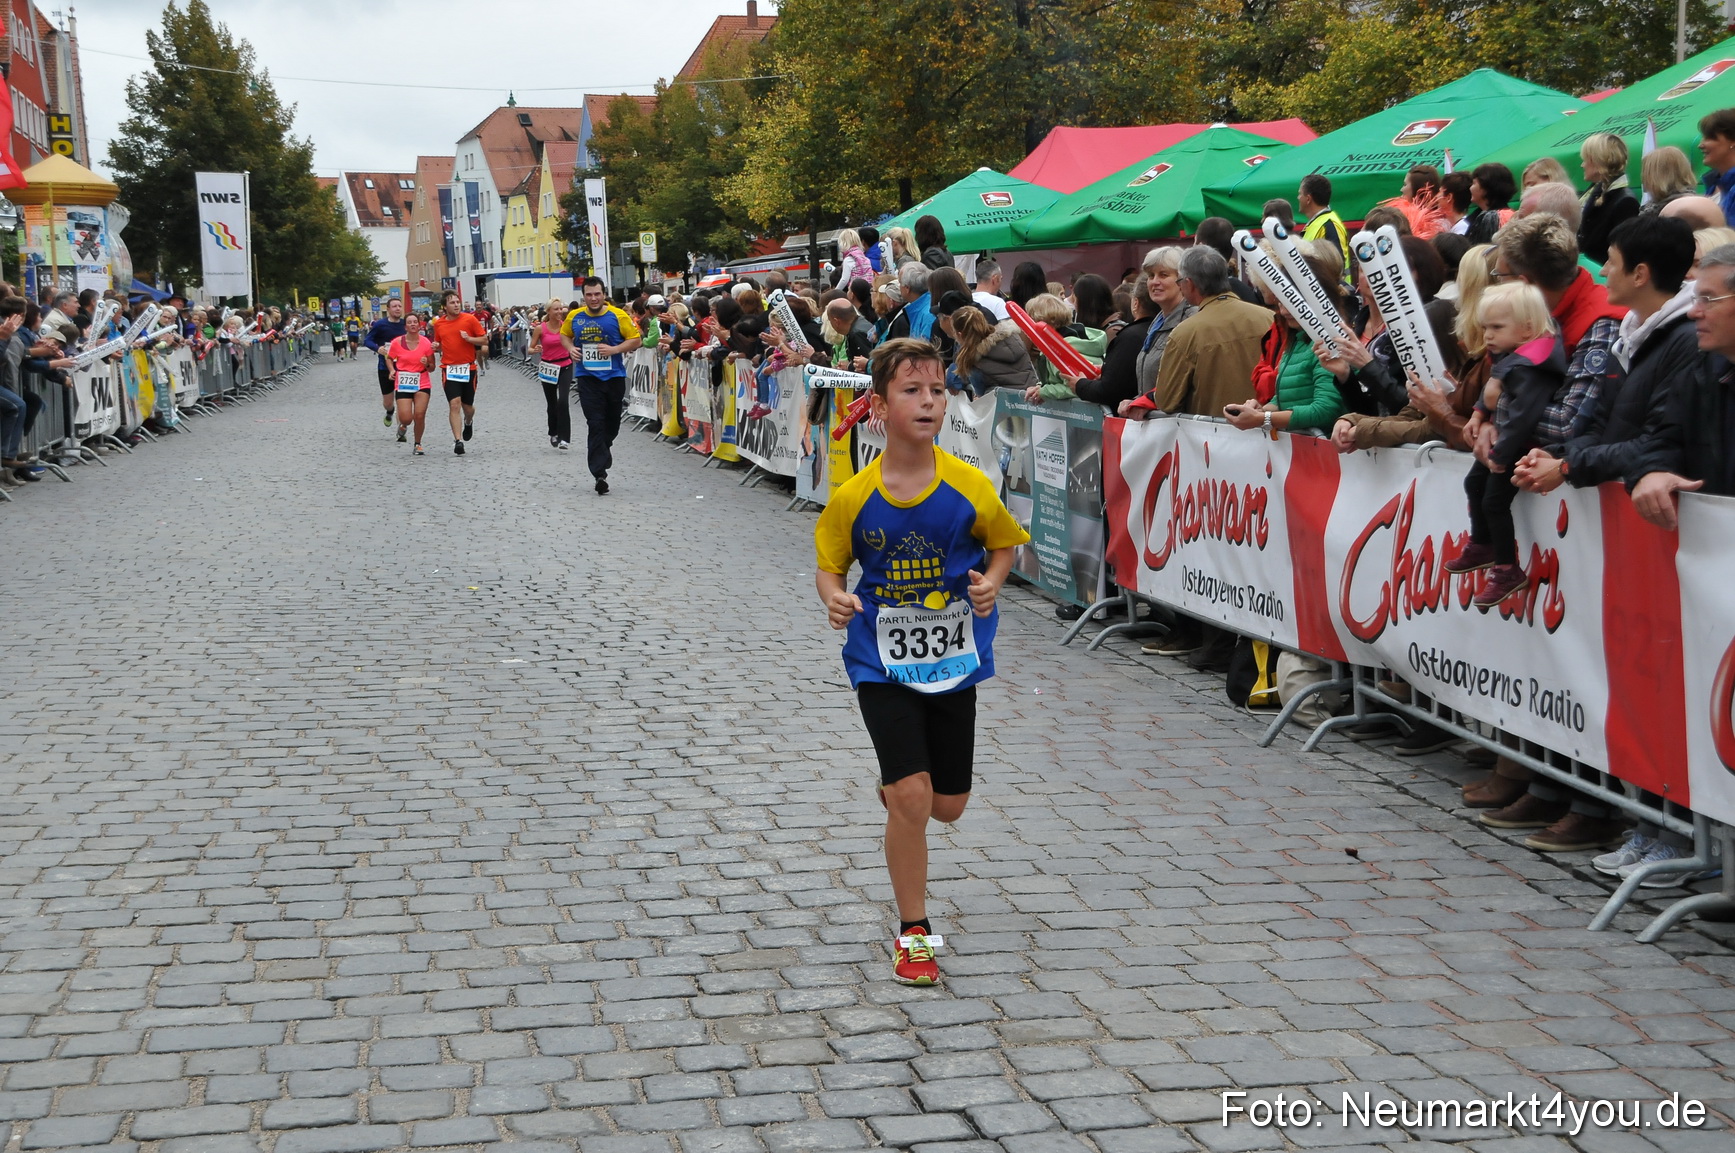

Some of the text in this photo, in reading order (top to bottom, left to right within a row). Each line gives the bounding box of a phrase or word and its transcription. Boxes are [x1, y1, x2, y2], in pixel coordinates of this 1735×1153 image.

[1341, 148, 1455, 163] Neumarkter
[954, 214, 1023, 227] Lamms
[966, 208, 1036, 219] Neumarkte
[1287, 246, 1350, 342] bmw-laufsport.
[1367, 269, 1398, 314] BMW
[1386, 315, 1421, 388] Laufspo
[449, 366, 468, 375] 2117
[540, 365, 558, 377] 2114
[399, 376, 419, 386] 2726
[830, 379, 872, 389] BMW Lauf
[1143, 439, 1269, 572] Charivari
[1181, 564, 1284, 622] Ostbayerns Radio
[878, 611, 961, 625] PARTL Neumarkt
[888, 620, 966, 660] 3334
[1407, 641, 1586, 734] Ostbayerns Radio
